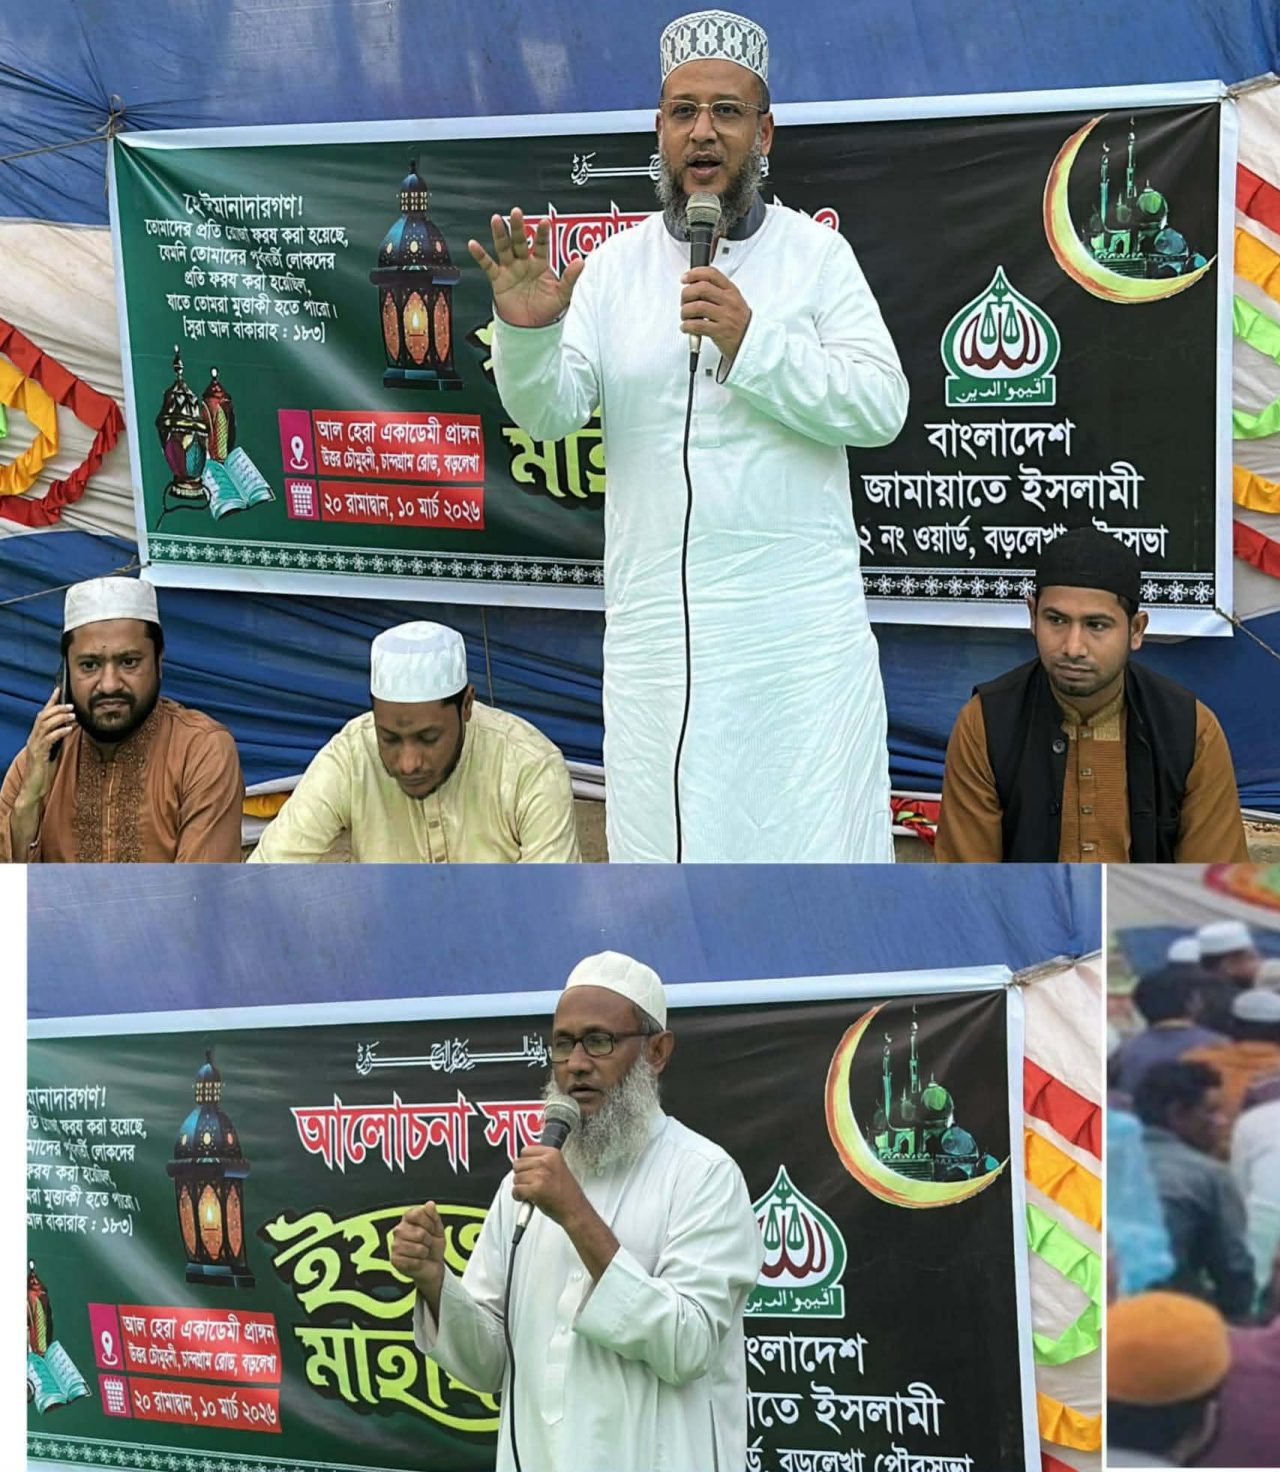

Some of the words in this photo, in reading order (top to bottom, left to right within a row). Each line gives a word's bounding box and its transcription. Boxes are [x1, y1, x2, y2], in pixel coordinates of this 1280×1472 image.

[143, 219, 193, 238] তোমাদের
[196, 218, 222, 240] প্রতি
[280, 226, 306, 245] করা
[307, 226, 349, 248] হয়েছে,
[190, 246, 247, 266] তোমাদের
[286, 251, 337, 270] লোকদের
[184, 265, 206, 288] প্রতি
[240, 272, 267, 291] করা
[165, 293, 191, 311] যাতে
[194, 295, 228, 315] তোমরা
[230, 293, 272, 318] মুত্তাকী
[274, 299, 300, 318] হতে
[207, 320, 230, 339] আল
[232, 320, 279, 342] বাকারাহ
[316, 419, 343, 442] আল
[347, 420, 377, 444] হেরা
[381, 416, 442, 445] একাডেমী
[924, 417, 1077, 460] বাংলাদেশ
[861, 470, 1012, 510] জামায়াতে
[1018, 461, 1146, 512] ইসলামী
[323, 493, 342, 516] ২০
[397, 496, 415, 518] ১০
[417, 490, 440, 521] মার্চ
[443, 499, 481, 524] ২০২৬
[878, 525, 908, 556] নং
[912, 515, 977, 561] ওয়ার্ড,
[85, 1116, 108, 1137] করা
[289, 1088, 478, 1175] আলোচনা
[91, 1143, 136, 1163] লোকদের
[55, 1164, 80, 1183] করা
[85, 1190, 109, 1210] হতে
[44, 1212, 89, 1235] বাকারাহ
[122, 1315, 147, 1338] আল
[150, 1315, 177, 1341] হেরা
[181, 1313, 240, 1344] একাডেমী
[134, 1389, 152, 1413] ২০
[200, 1395, 217, 1419] ১০
[217, 1392, 239, 1421] মার্চ
[242, 1400, 277, 1426] ২০২৬
[810, 1380, 946, 1436] ইসলামী
